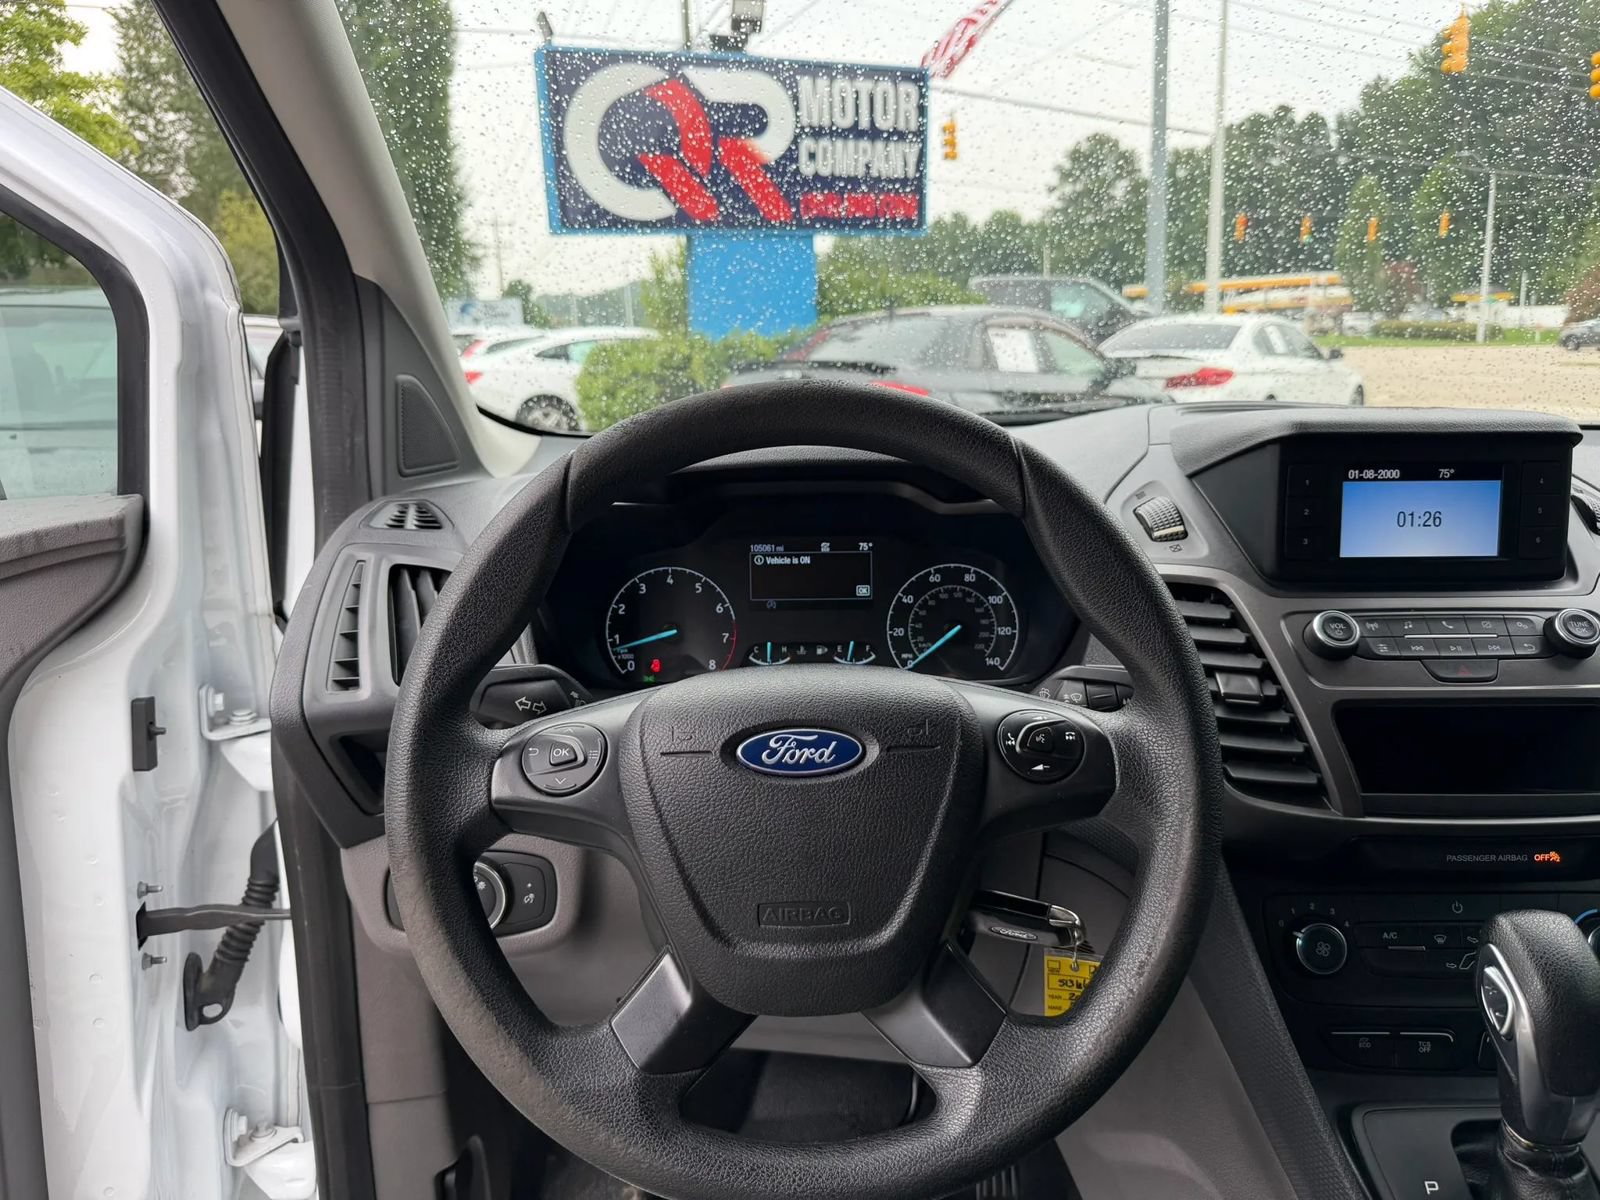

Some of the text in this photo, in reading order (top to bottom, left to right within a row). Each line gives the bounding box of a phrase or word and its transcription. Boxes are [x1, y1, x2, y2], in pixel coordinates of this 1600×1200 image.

[797, 75, 919, 132] MOTOR
[798, 138, 920, 179] COMPANY
[1348, 469, 1400, 479] 01-08-2000
[1396, 510, 1442, 528] 01:26
[750, 544, 775, 552] 105061
[766, 556, 810, 564] Vehicle is ON
[666, 575, 674, 585] 4
[928, 573, 941, 582] 60
[964, 573, 976, 582] 80
[639, 583, 647, 594] 3
[695, 582, 702, 593] 5
[902, 595, 914, 604] 40
[988, 595, 1003, 604] 100
[618, 603, 625, 614] 2
[715, 602, 724, 613] 6
[1569, 620, 1590, 628] TUNE
[892, 627, 904, 637] 20
[997, 626, 1012, 635] 120
[614, 634, 620, 644] 1
[722, 633, 729, 643] 7
[627, 661, 635, 671] 0
[708, 659, 716, 670] 8
[985, 657, 1001, 666] 140
[553, 748, 570, 757] OK
[761, 734, 837, 765] Ford
[1446, 854, 1528, 862] PASSENGER AIRBAG
[1533, 853, 1550, 861] OFF
[762, 907, 842, 921] AIRBAG
[1382, 931, 1398, 940] A/C
[1424, 1181, 1439, 1195] P
